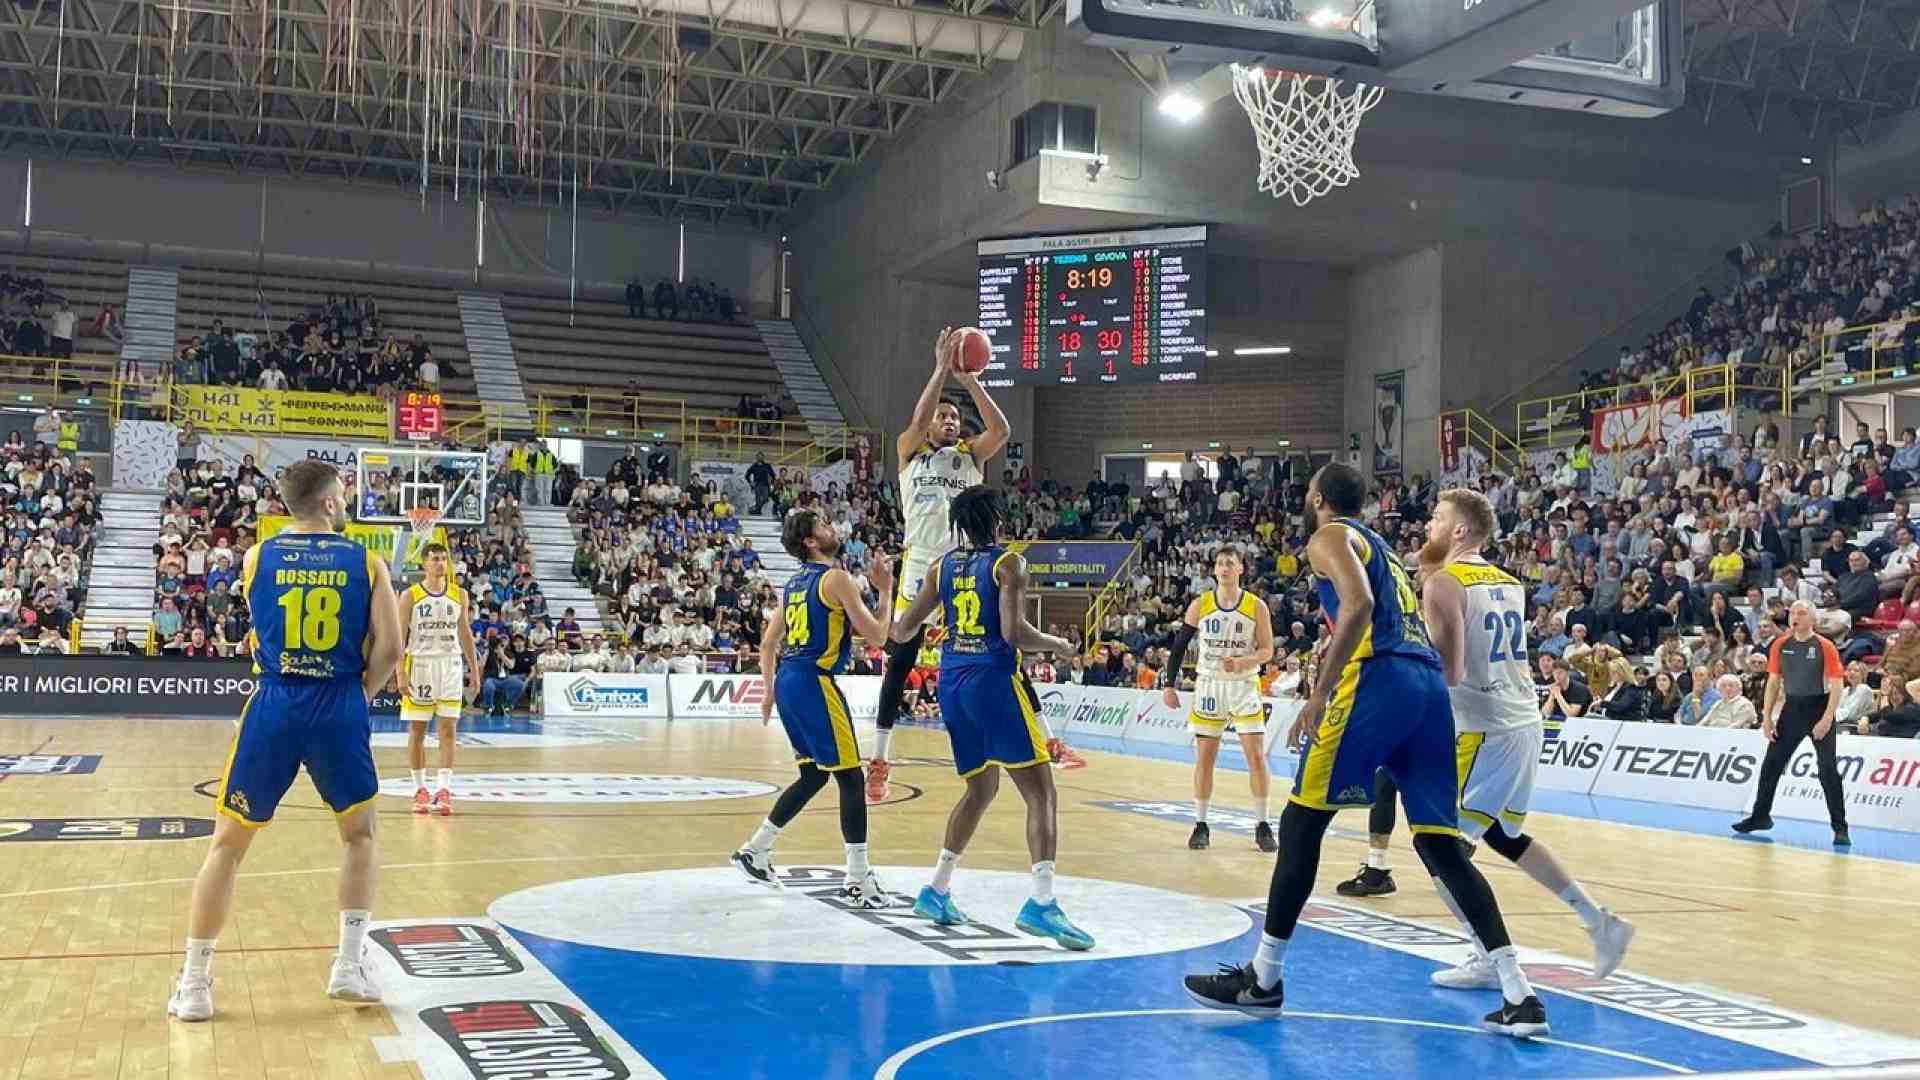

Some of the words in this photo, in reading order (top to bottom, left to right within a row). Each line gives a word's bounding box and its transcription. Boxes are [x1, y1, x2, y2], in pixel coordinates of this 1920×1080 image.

[1067, 267, 1112, 289] 8:19
[1058, 332, 1081, 351] 18
[1098, 330, 1122, 349] 30
[1064, 361, 1073, 376] 1
[1105, 359, 1114, 374] 1
[399, 407, 438, 432] 3.3
[275, 569, 348, 587] ROSSATO
[1052, 563, 1106, 575] HOSPITALITY
[418, 603, 432, 617] 12
[278, 587, 341, 652] 18
[1205, 618, 1220, 634] 10
[1484, 609, 1527, 663] 22
[35, 676, 132, 694] MIGLIORI
[137, 678, 207, 694] EVENTI
[417, 684, 433, 698] 12
[1201, 695, 1216, 711] 10
[1072, 699, 1129, 726] iziwork
